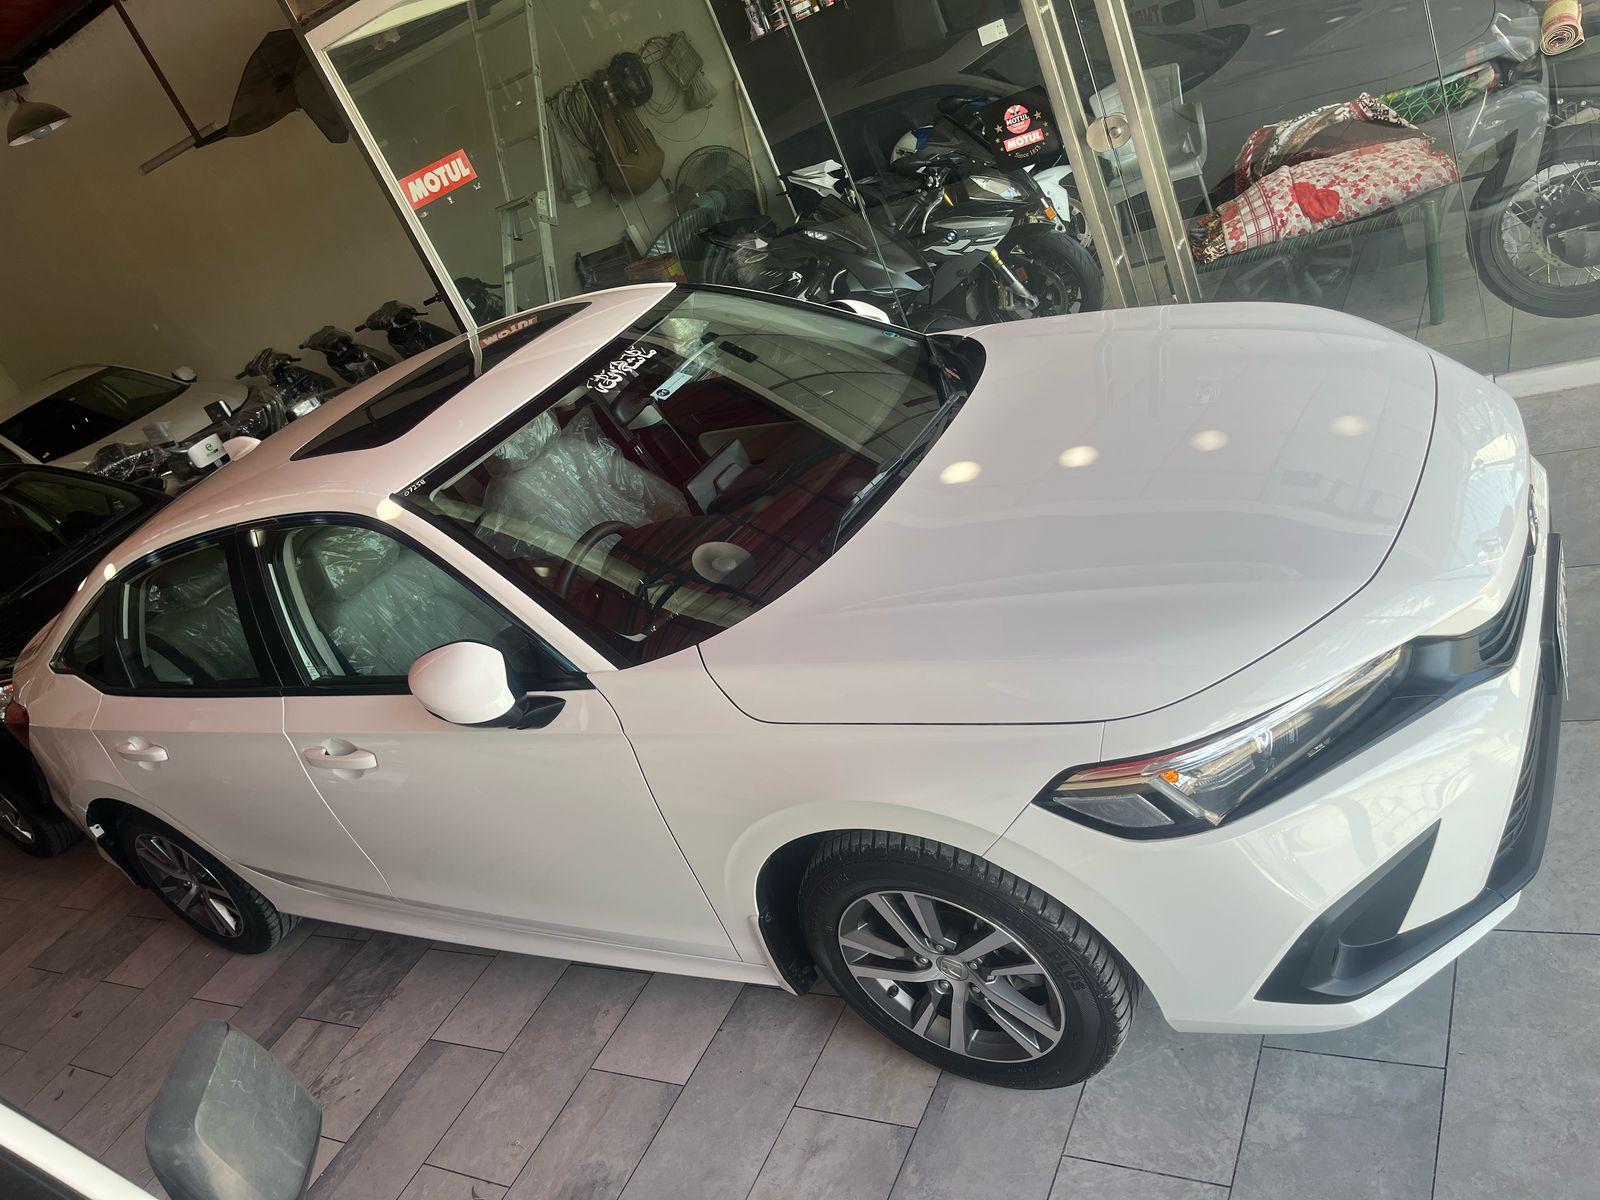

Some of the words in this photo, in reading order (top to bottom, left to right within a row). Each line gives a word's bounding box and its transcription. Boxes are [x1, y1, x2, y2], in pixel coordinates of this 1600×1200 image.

[1005, 113, 1030, 126] MOTUL
[1007, 131, 1041, 149] MOTUL
[407, 157, 470, 203] MOTUL
